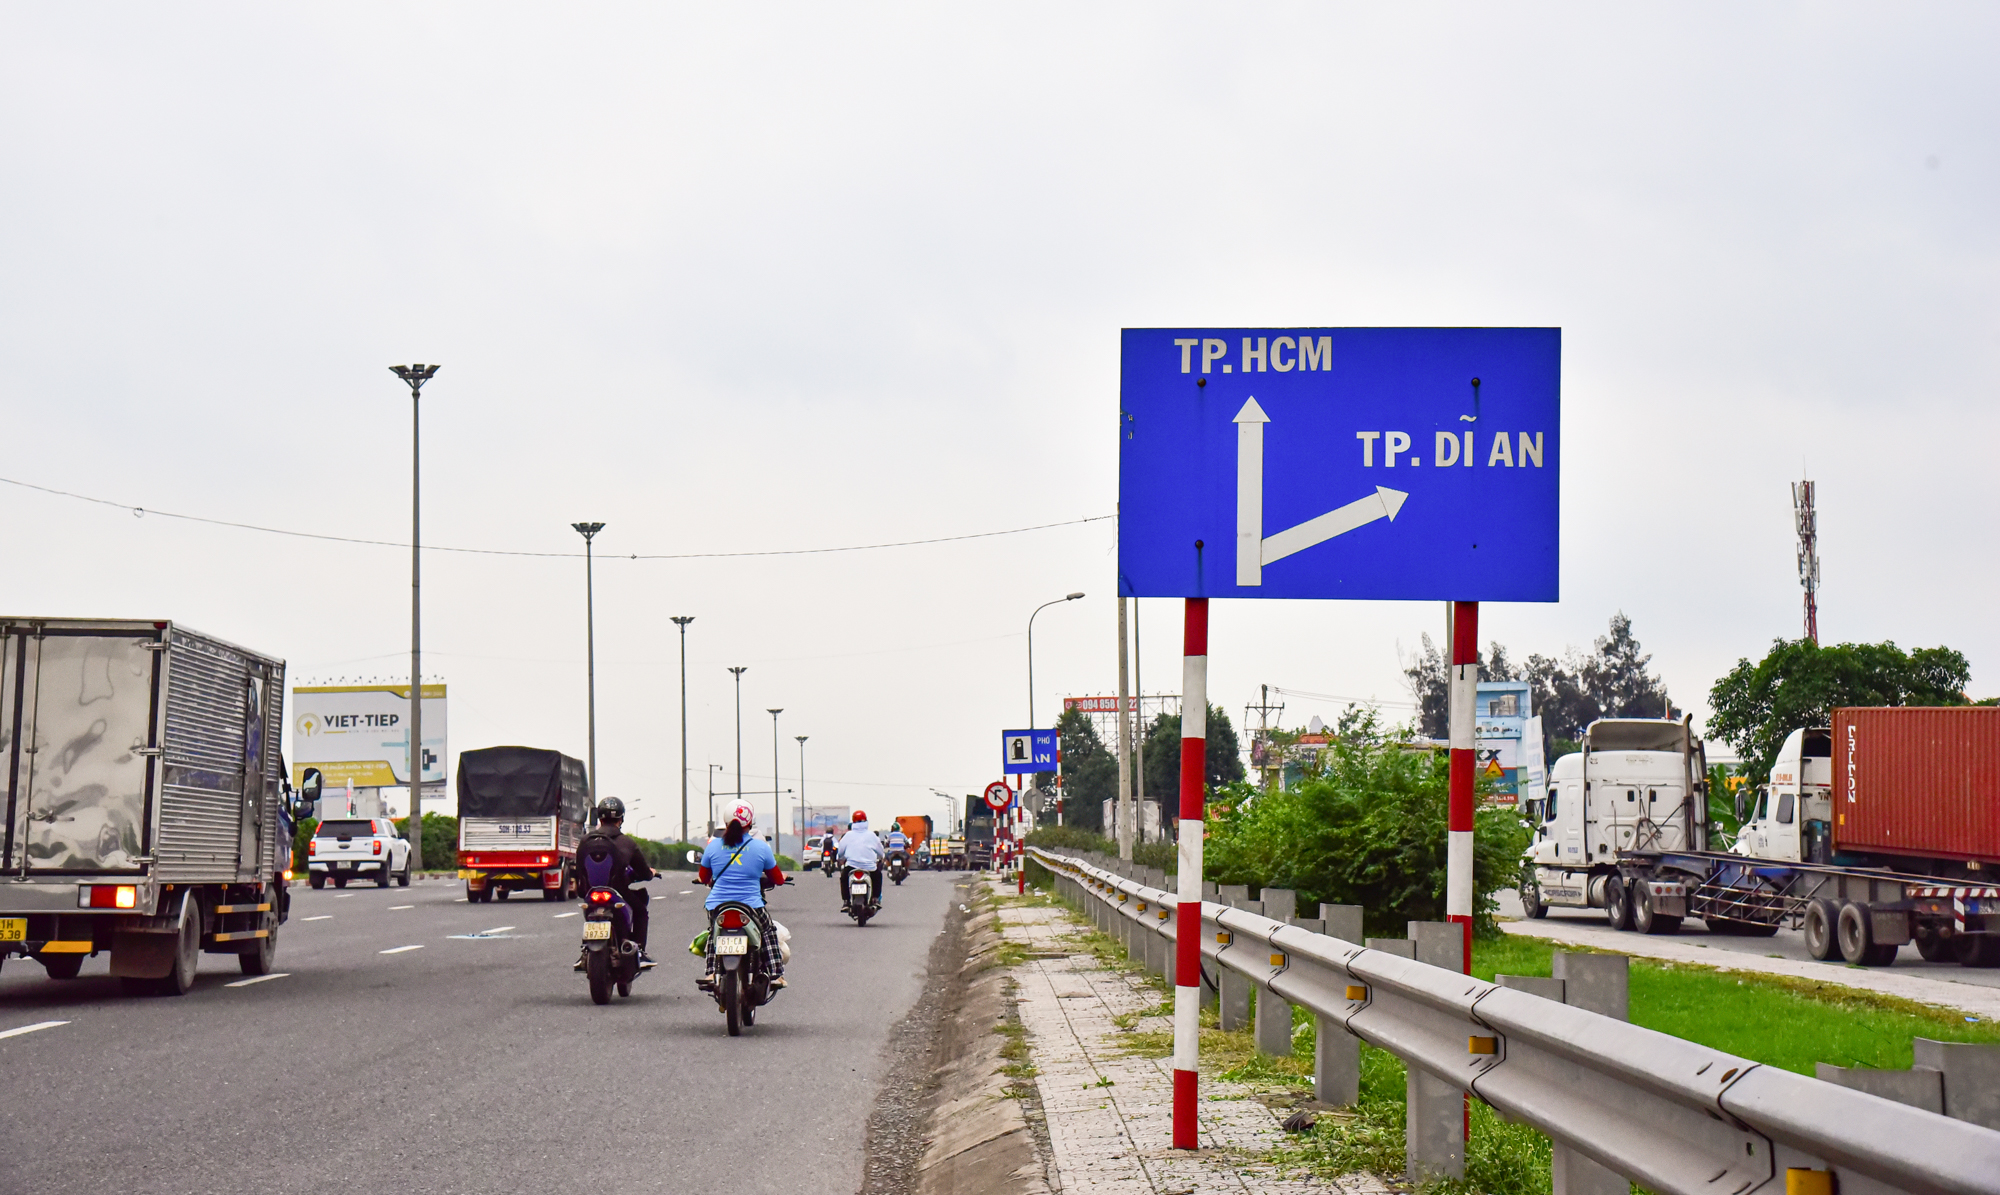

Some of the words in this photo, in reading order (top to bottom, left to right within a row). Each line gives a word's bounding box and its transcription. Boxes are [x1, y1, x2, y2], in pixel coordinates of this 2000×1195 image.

[1174, 338, 1232, 374] TP.
[1242, 336, 1332, 373] HCM
[1356, 431, 1421, 467] TP.
[1435, 414, 1477, 467] DĨ
[1488, 431, 1544, 467] AN
[1082, 699, 1098, 710] 094
[1099, 699, 1115, 710] 858
[324, 714, 399, 727] VIET-TIEP
[730, 853, 743, 865] K
